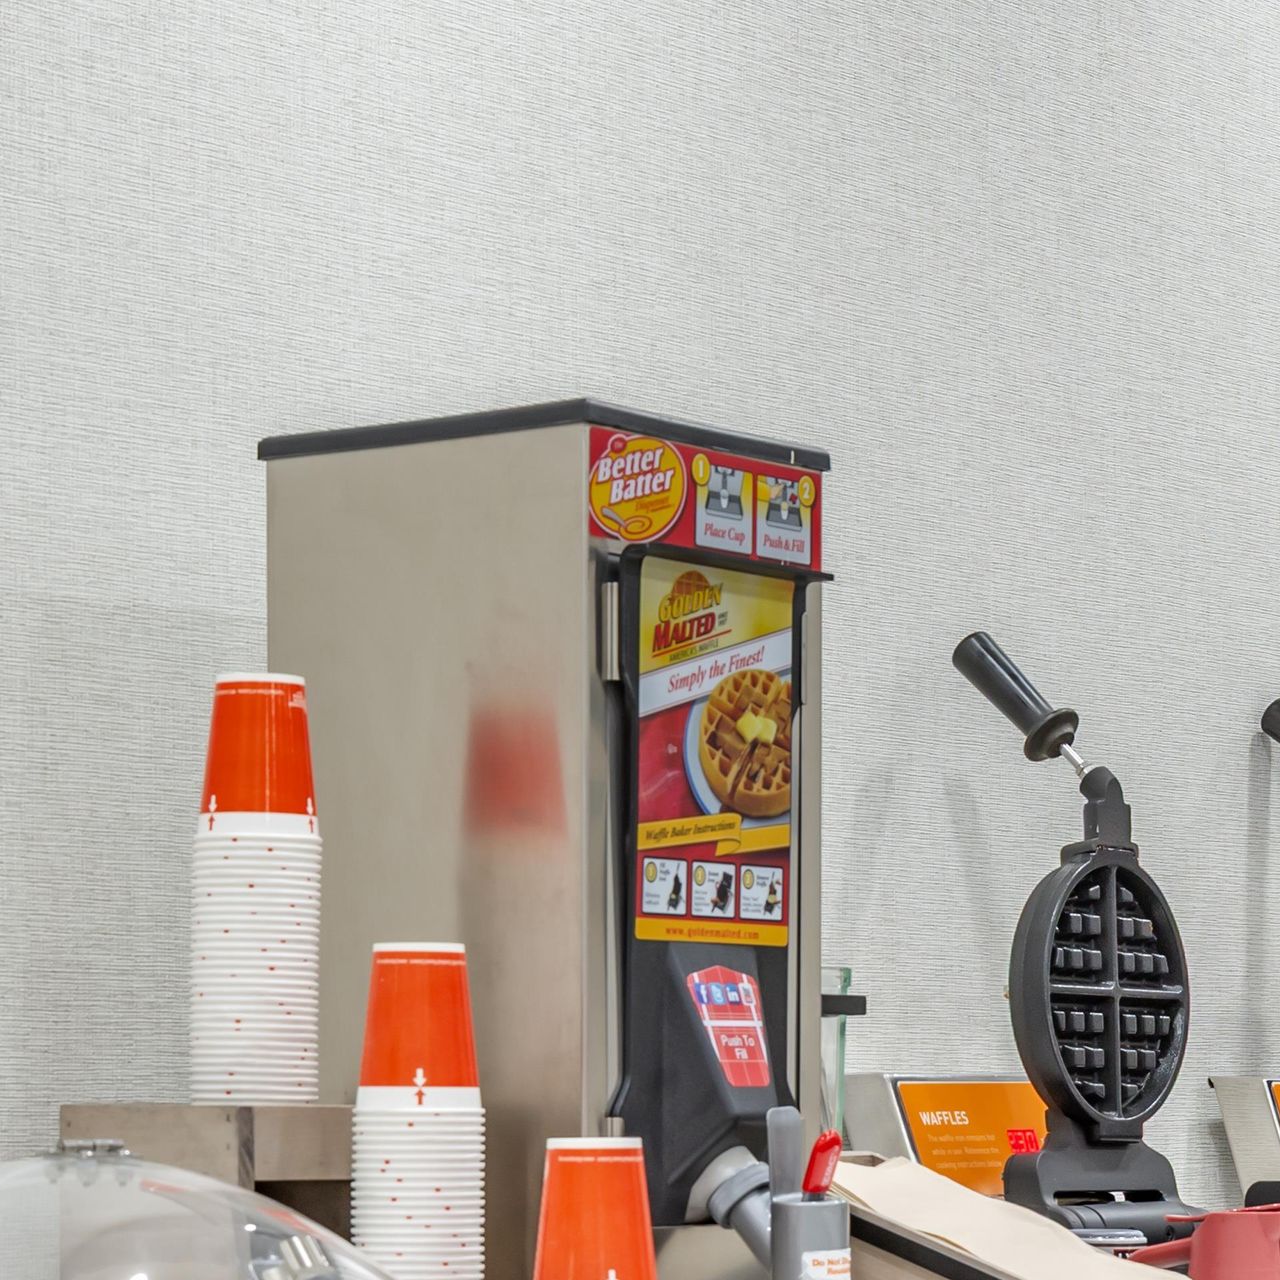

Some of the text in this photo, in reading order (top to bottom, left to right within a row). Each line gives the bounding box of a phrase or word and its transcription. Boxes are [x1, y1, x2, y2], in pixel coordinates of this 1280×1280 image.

[597, 447, 664, 482] Better
[699, 460, 705, 479] 1
[610, 469, 675, 504] Batter
[802, 482, 811, 499] 2
[704, 523, 746, 546] Place Cup
[763, 533, 806, 553] Push & Fill
[658, 583, 724, 623] GOLDEN
[652, 612, 716, 653] MALTED
[668, 645, 766, 693] Simply the Finest!
[693, 822, 736, 835] Instructions
[720, 1034, 755, 1047] Push To
[734, 1048, 748, 1060] Fill
[919, 1111, 970, 1126] WAFFLES
